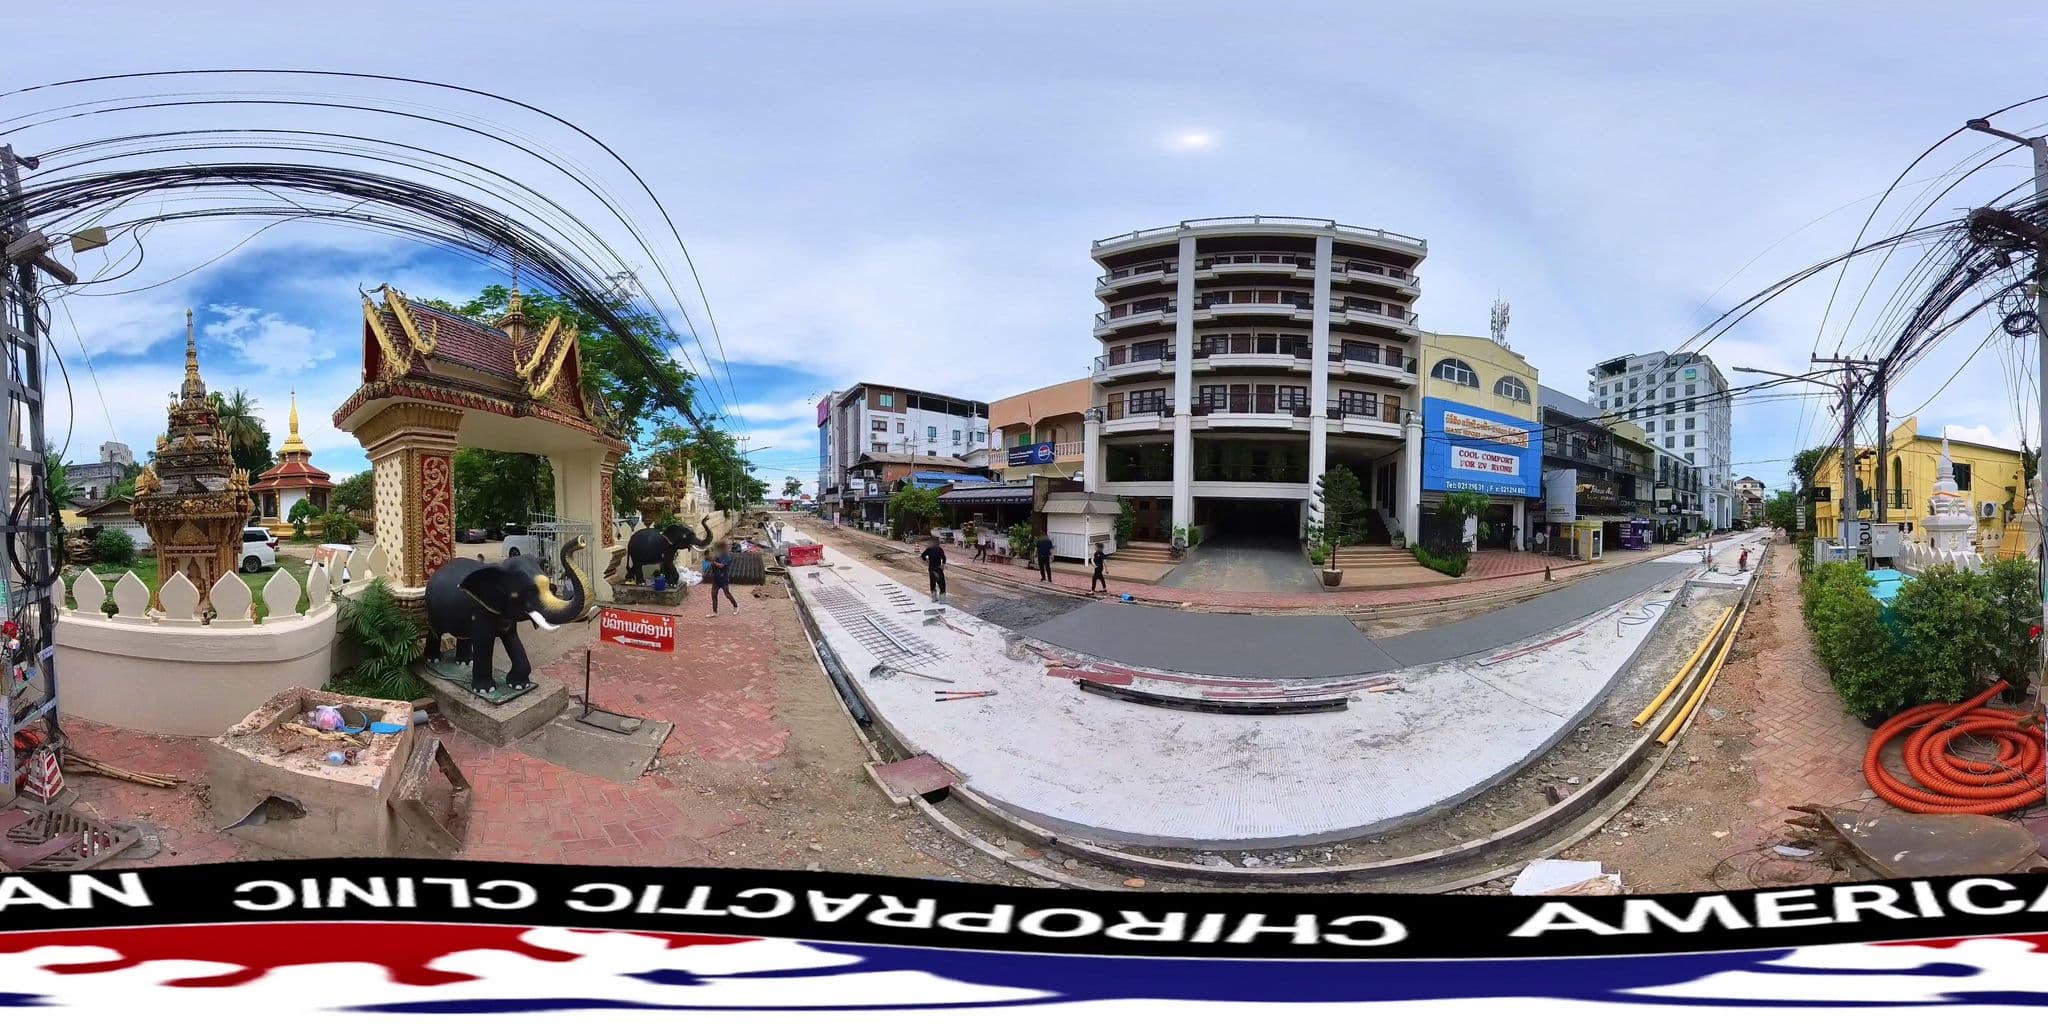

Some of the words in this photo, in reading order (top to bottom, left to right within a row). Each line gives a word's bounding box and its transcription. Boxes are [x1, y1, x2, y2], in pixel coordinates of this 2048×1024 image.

[1459, 450, 1479, 459] COOL
[1482, 453, 1514, 464] COMFORT
[1460, 460, 1475, 468] FOR
[1446, 481, 1456, 489] Tel:
[1457, 482, 1467, 490] 021
